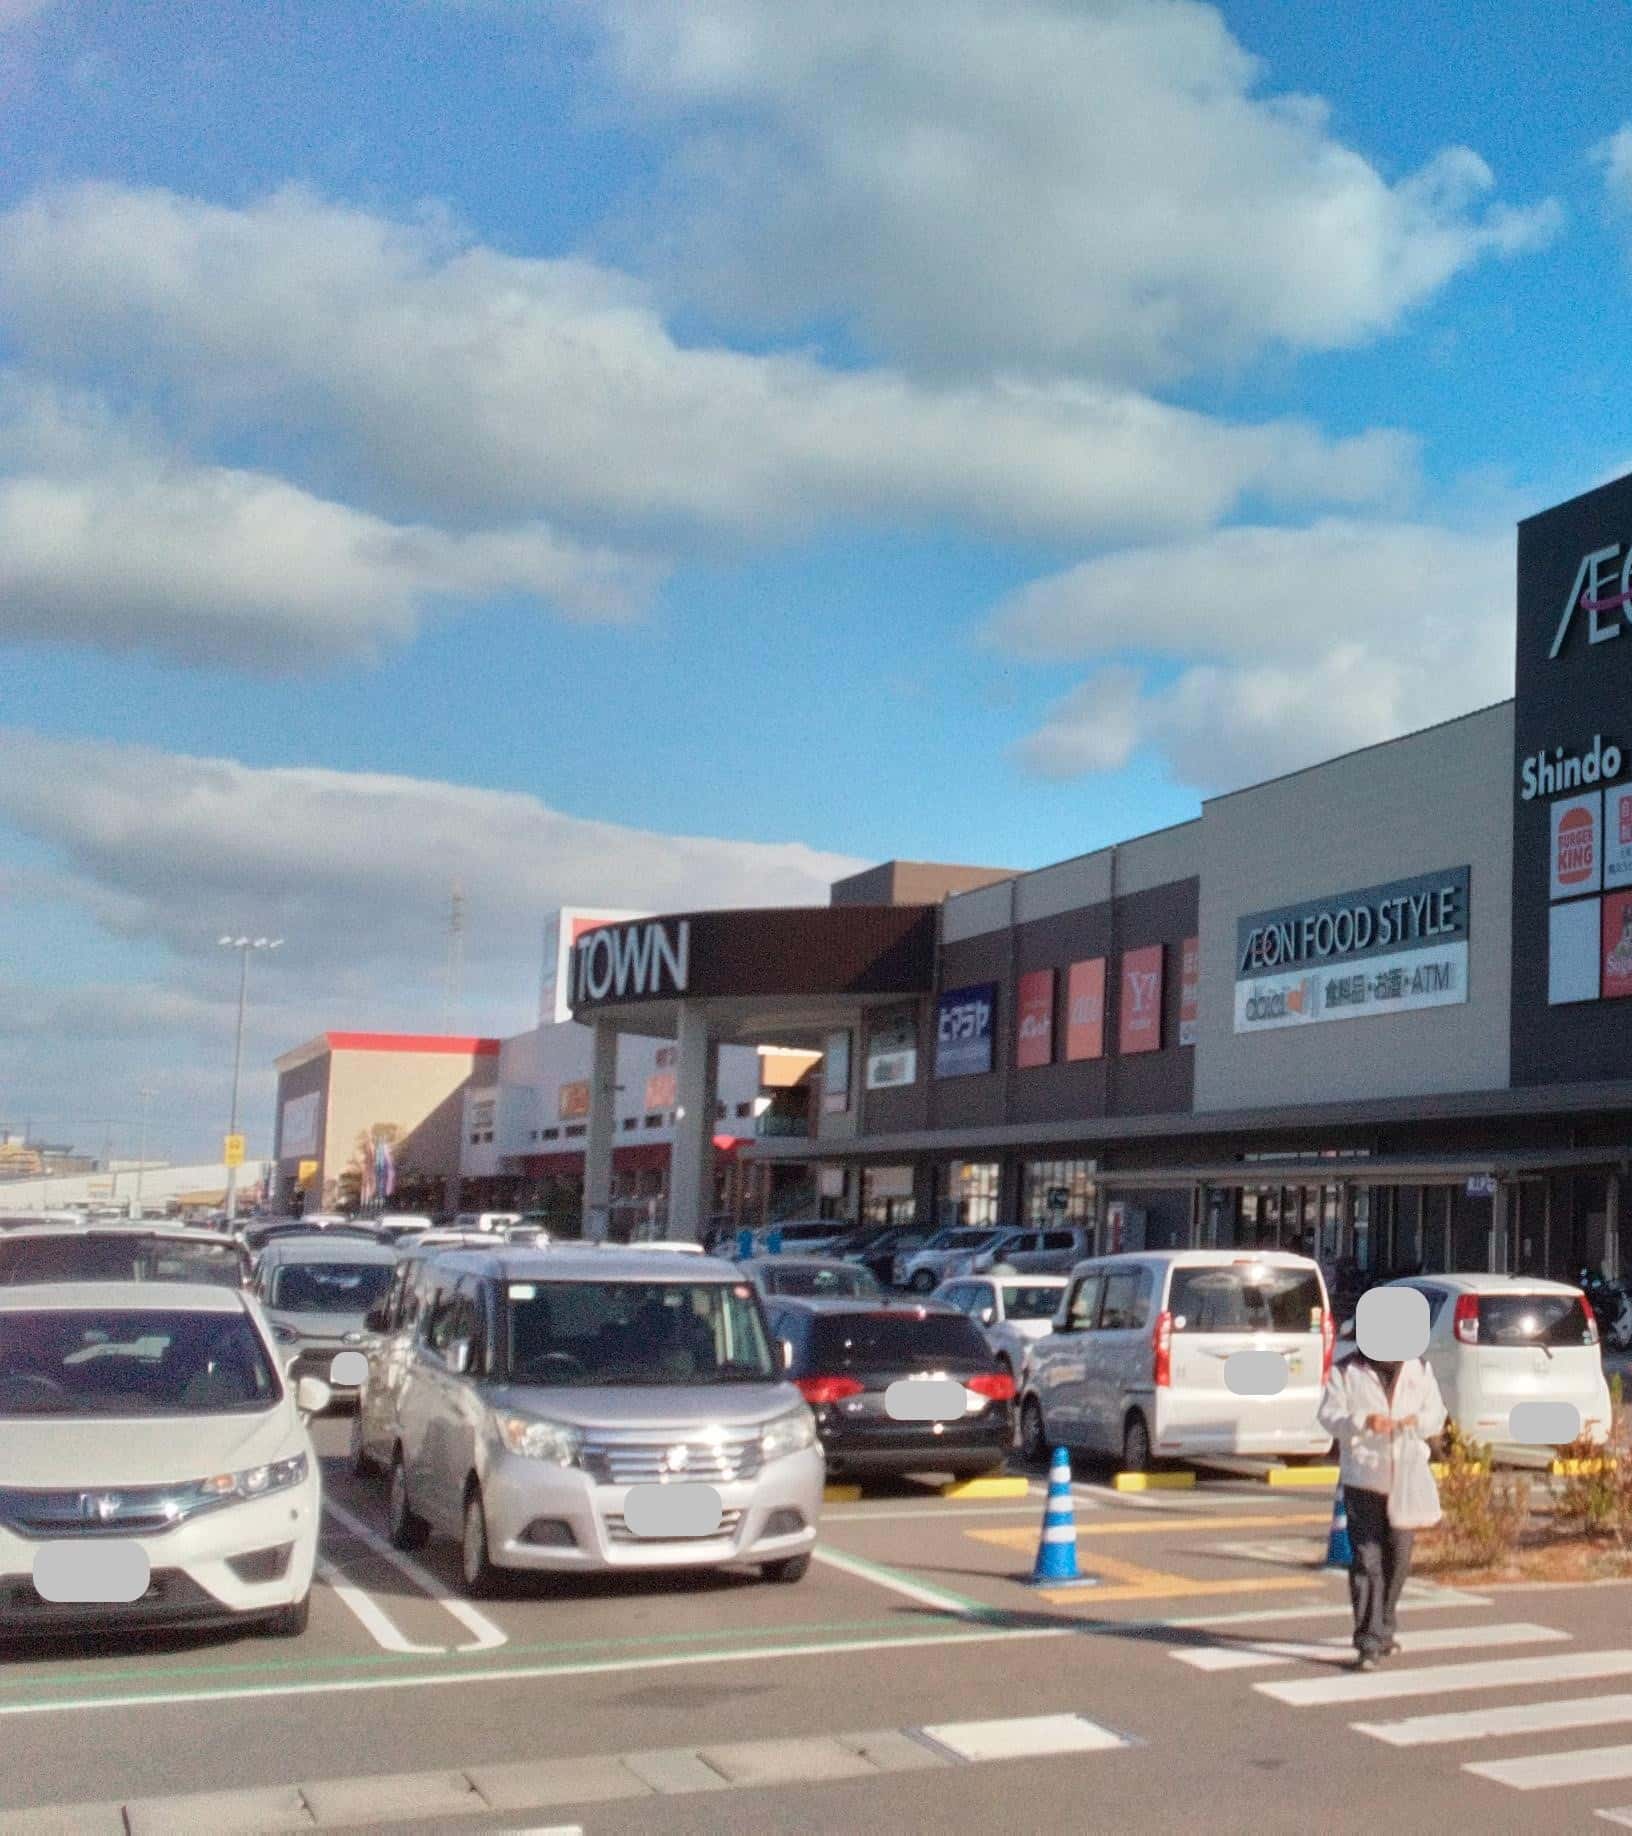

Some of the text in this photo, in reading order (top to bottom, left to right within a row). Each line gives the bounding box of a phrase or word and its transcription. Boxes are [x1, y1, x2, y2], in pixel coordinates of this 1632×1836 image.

[1521, 734, 1621, 801] Shindo
[1558, 845, 1593, 873] KING
[1303, 905, 1371, 959] FOOD
[1378, 886, 1455, 946] STYLE
[576, 920, 690, 1000] TOWN
